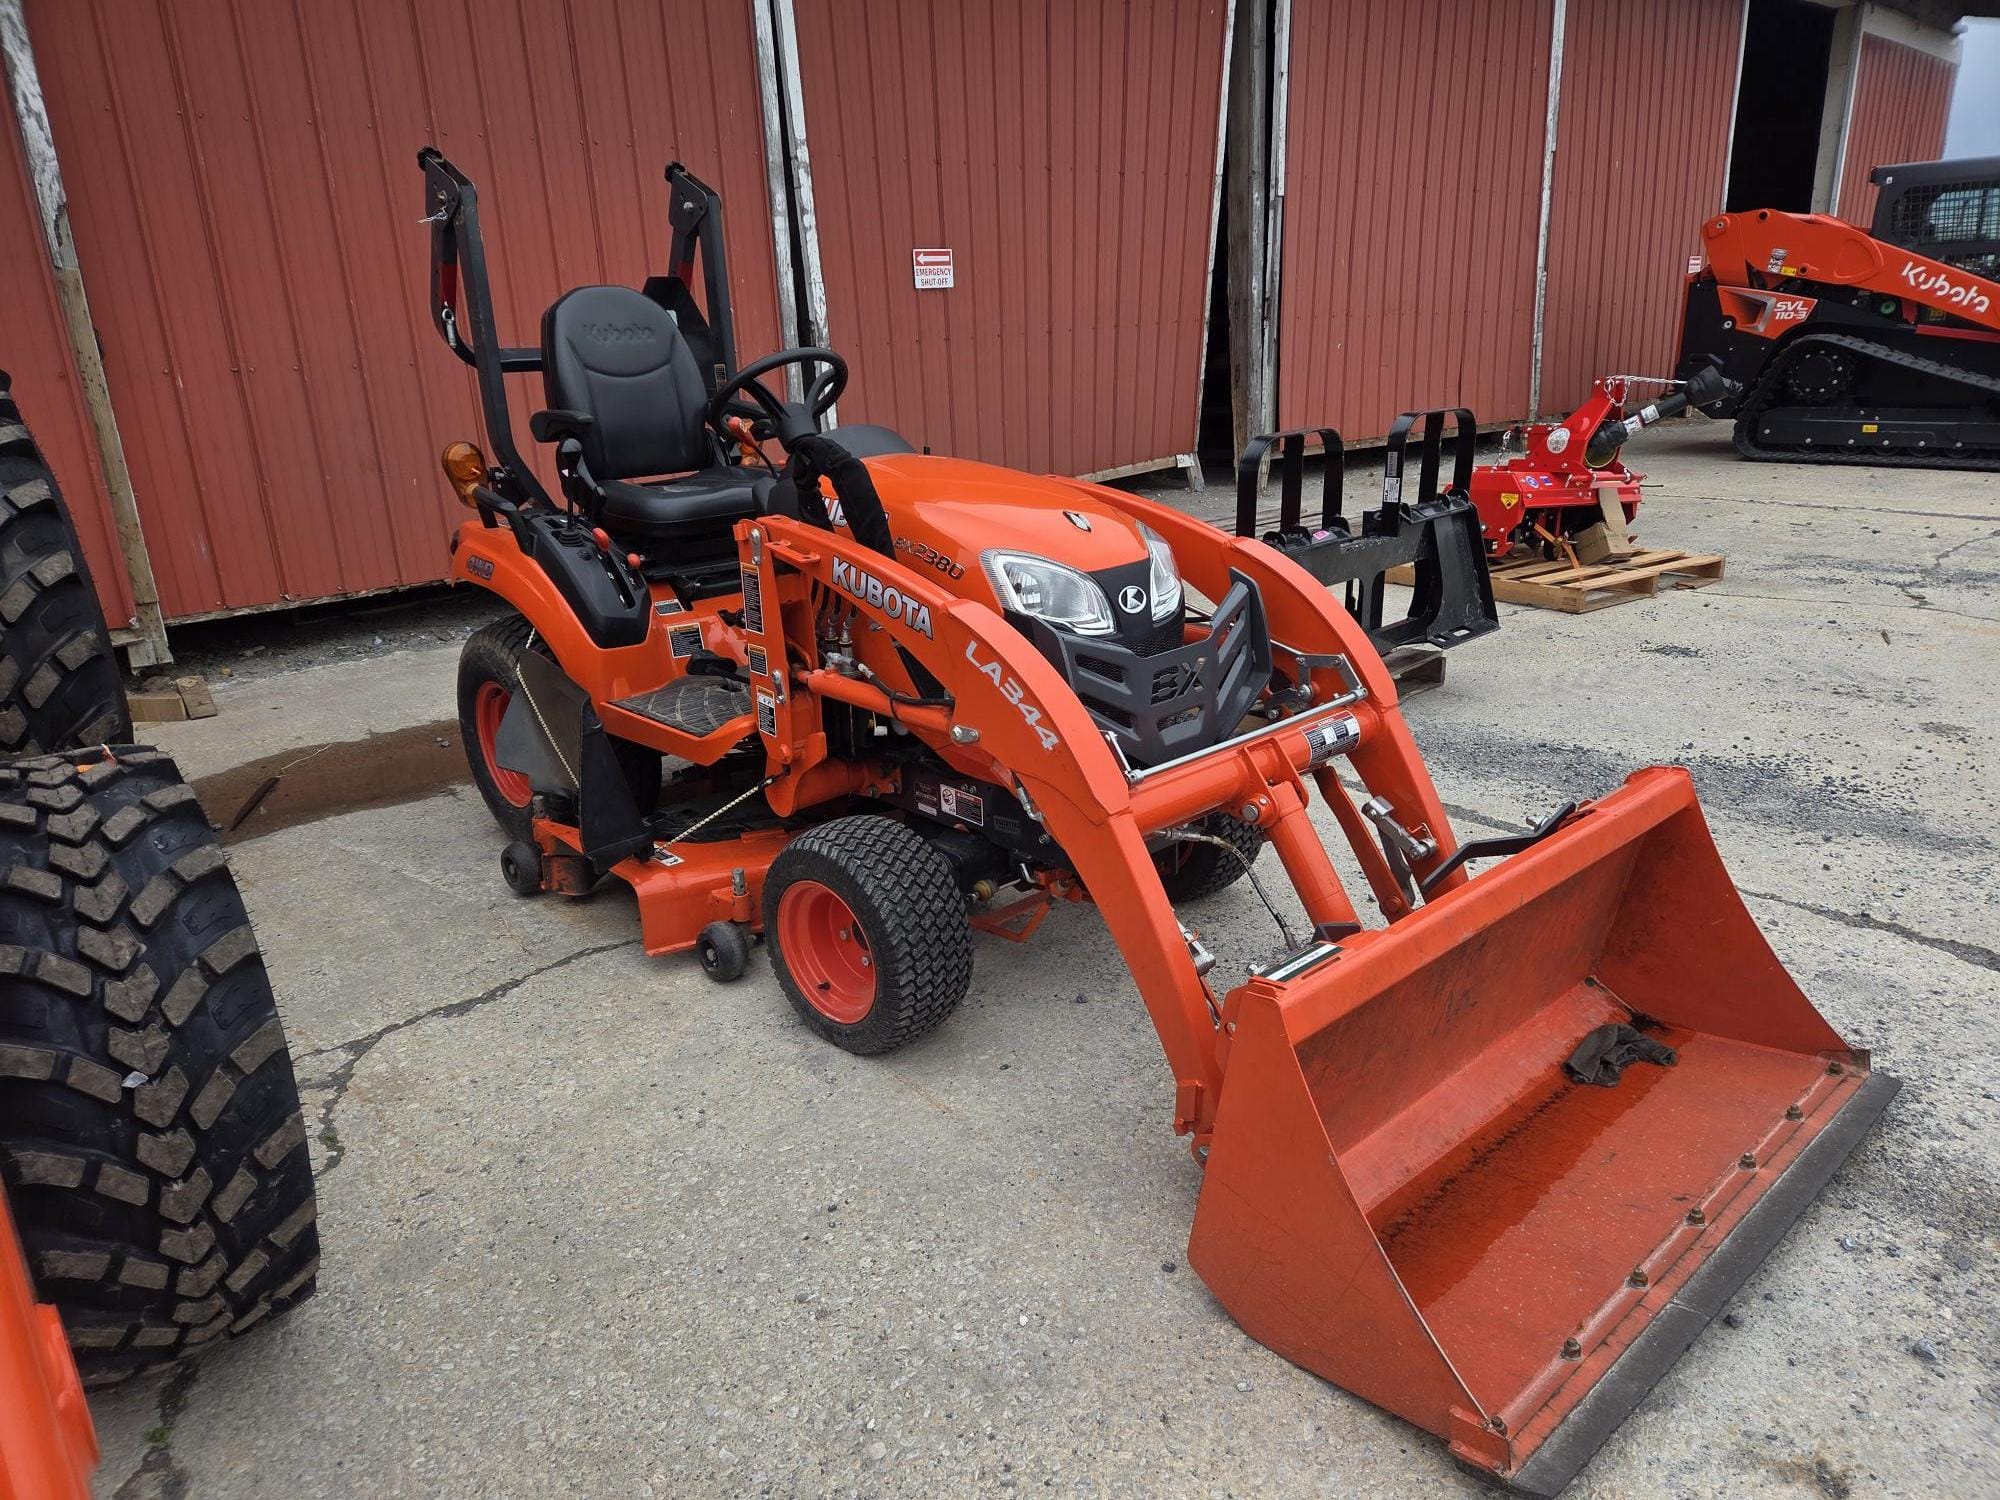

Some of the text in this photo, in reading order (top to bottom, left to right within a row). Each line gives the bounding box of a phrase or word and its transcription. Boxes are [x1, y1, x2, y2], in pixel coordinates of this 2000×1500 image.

[915, 267, 952, 277] EMERGENCY
[920, 277, 949, 287] SHUT-OFF
[1901, 261, 1990, 313] Kubota
[1774, 301, 1809, 312] SVL
[1775, 311, 1807, 320] 110-3
[582, 321, 656, 344] Kubota
[894, 535, 966, 580] BX2380
[831, 555, 934, 640] KUBOTA
[965, 640, 1060, 751] LA344
[1150, 656, 1206, 706] BX
